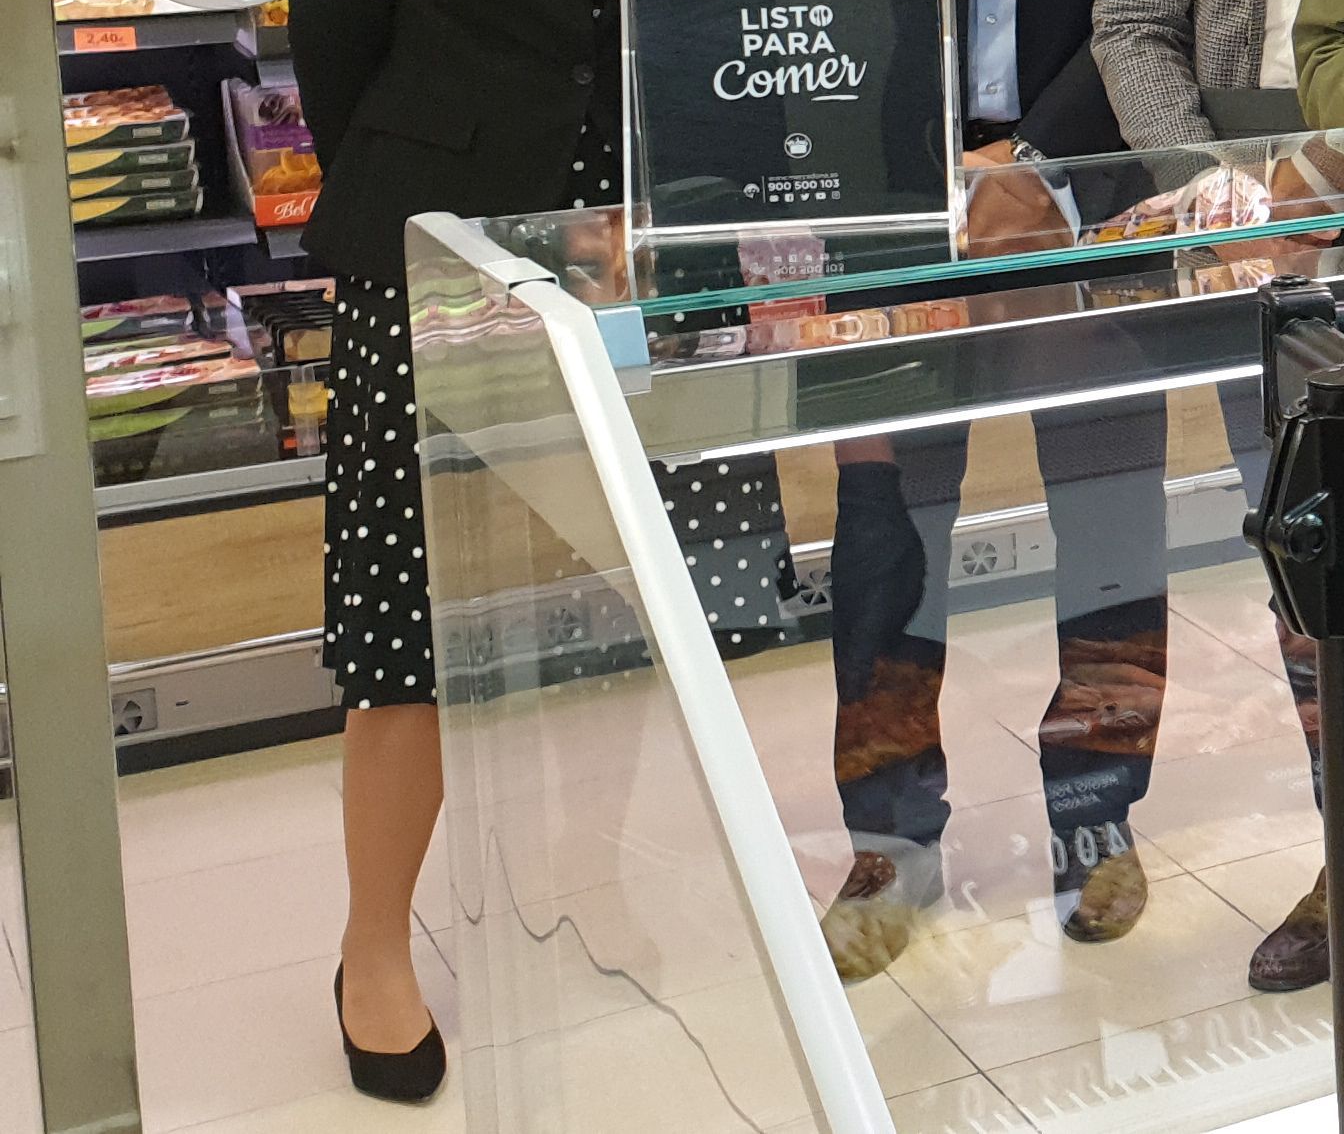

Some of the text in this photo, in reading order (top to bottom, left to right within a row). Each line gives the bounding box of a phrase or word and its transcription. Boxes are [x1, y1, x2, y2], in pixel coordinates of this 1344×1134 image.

[741, 4, 834, 31] LISTO
[743, 31, 836, 57] PARA
[713, 54, 868, 101] Comer
[768, 178, 840, 192] 900 500 103
[274, 197, 306, 220] Bel
